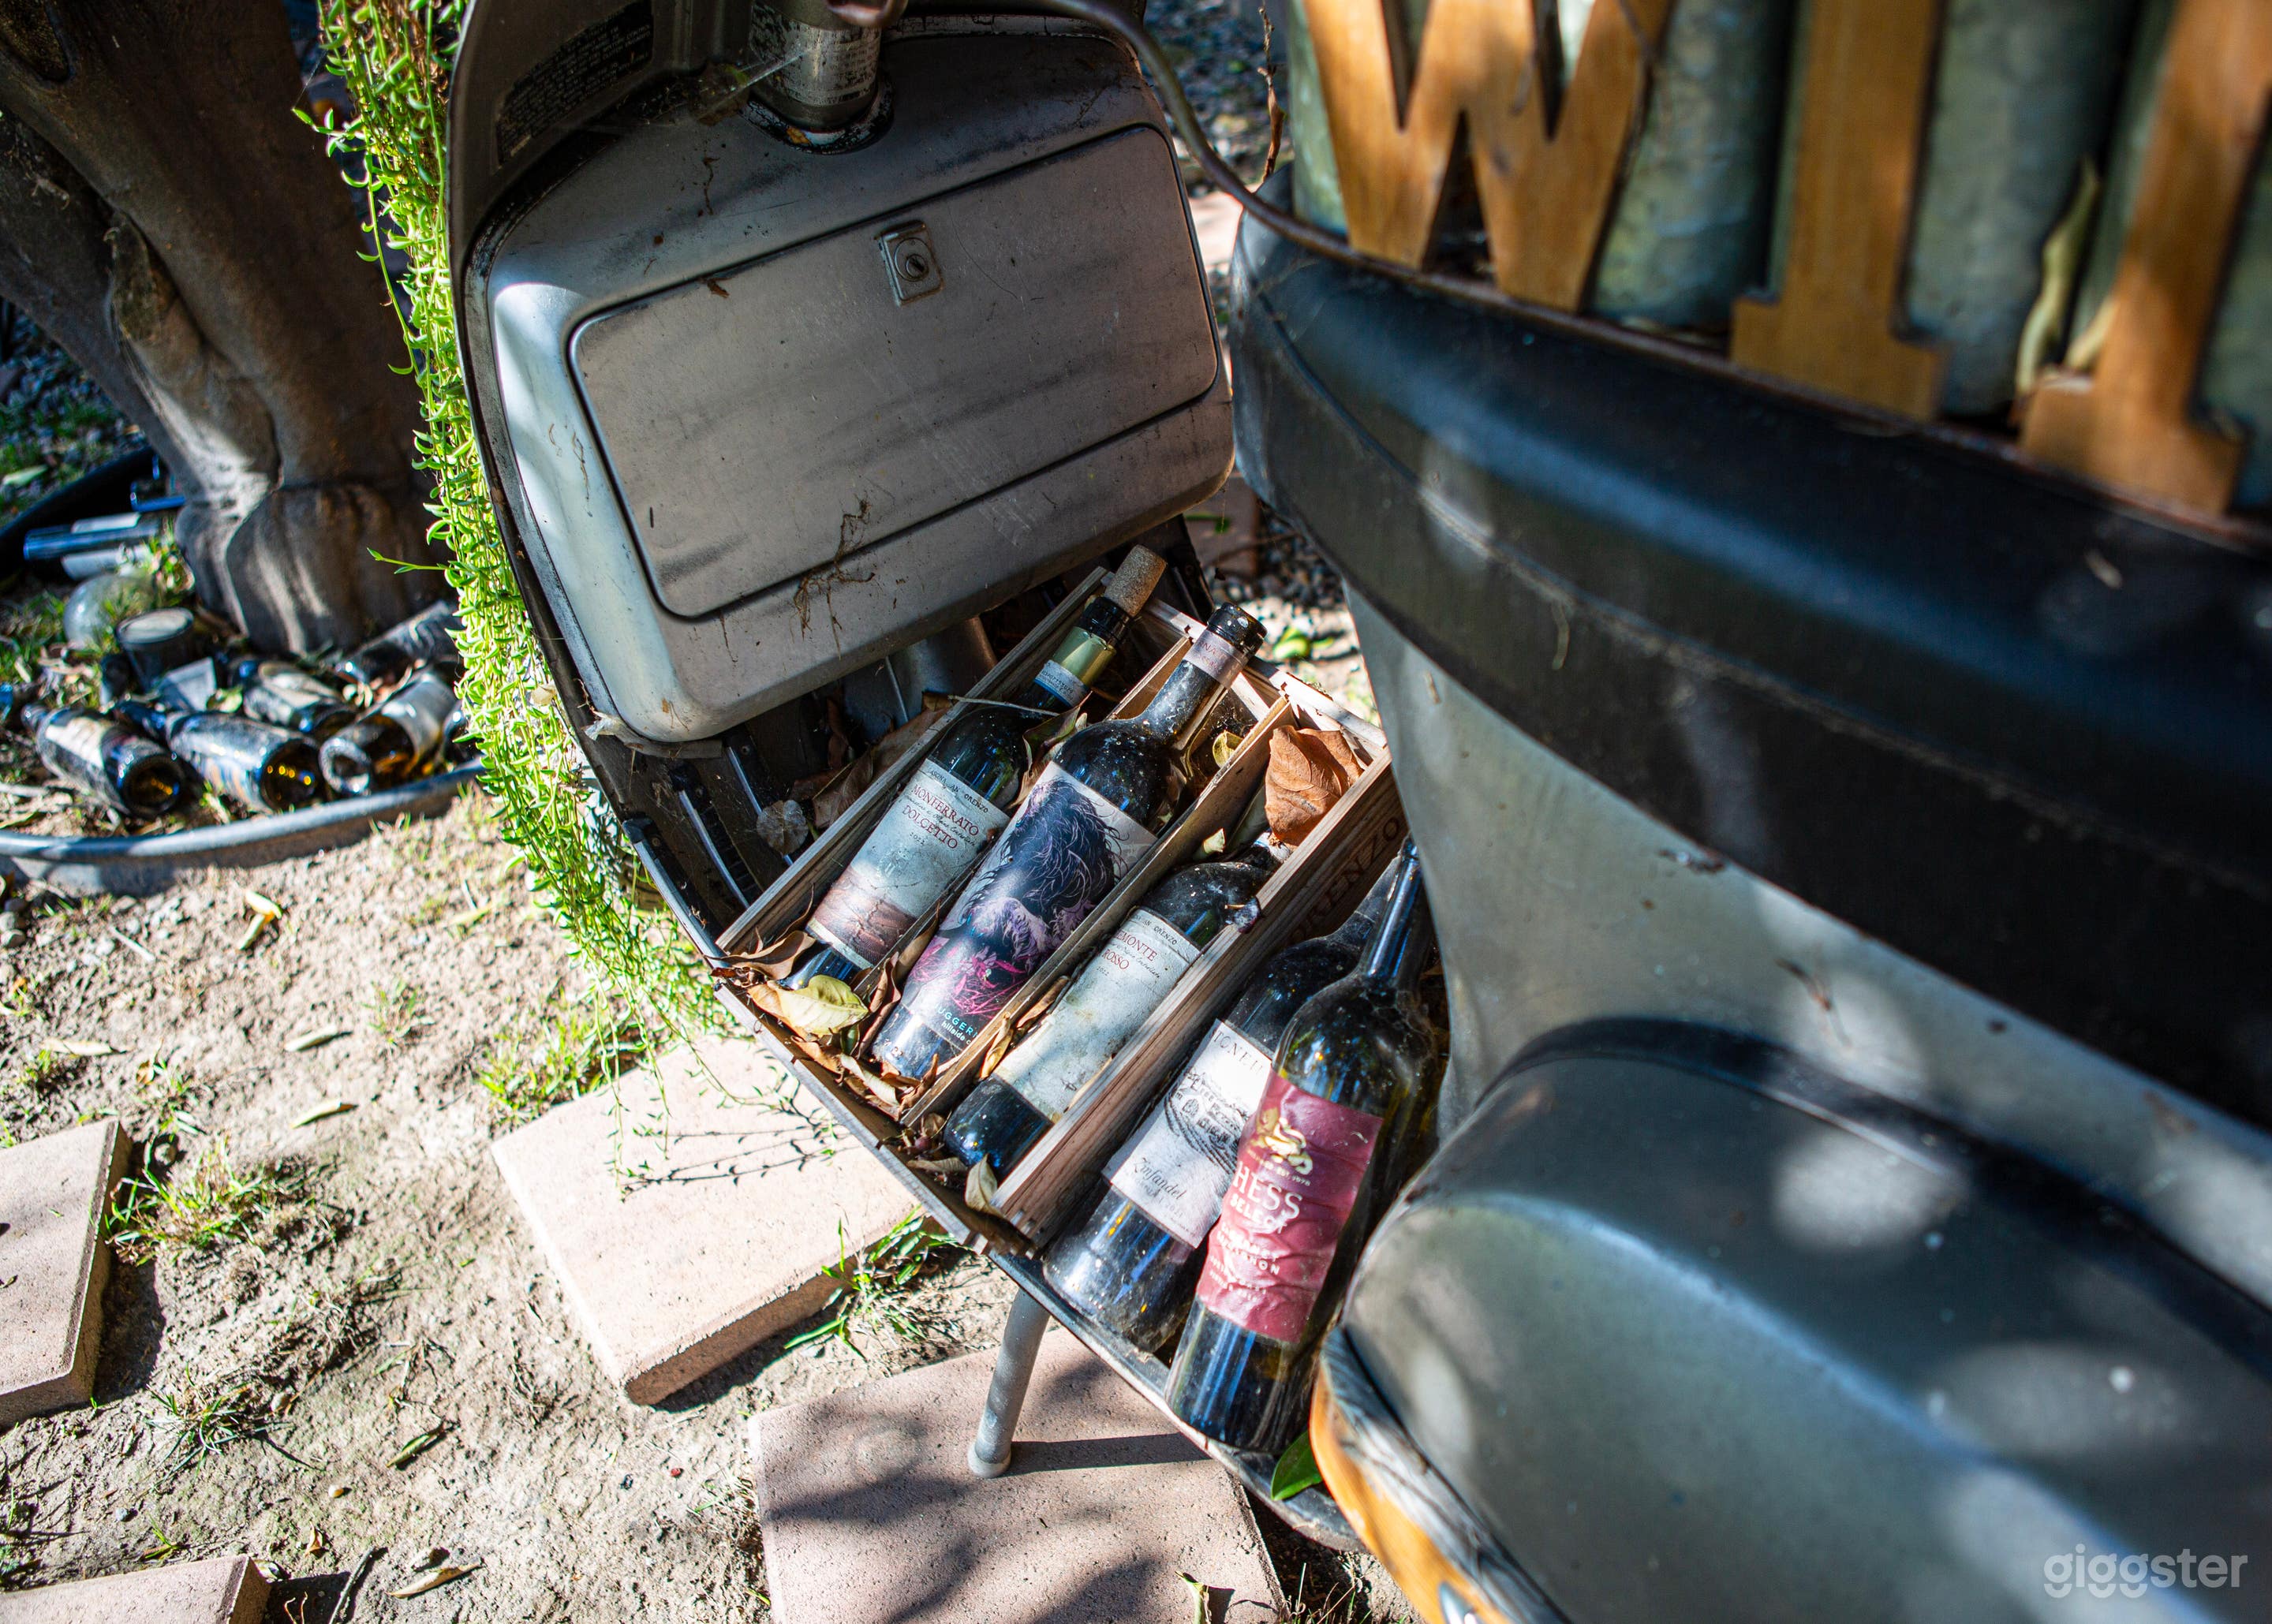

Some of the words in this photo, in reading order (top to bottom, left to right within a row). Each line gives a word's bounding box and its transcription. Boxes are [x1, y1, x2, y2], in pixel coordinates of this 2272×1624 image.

[902, 805, 958, 849] DOLCETTO
[911, 783, 980, 837] MONFERRATO
[1101, 948, 1130, 970] ROSSO
[1116, 930, 1158, 962] EMONTE
[941, 1020, 966, 1041] hillside
[1134, 1156, 1187, 1200] Zinfandel
[1232, 1160, 1303, 1219] HESS
[1230, 1193, 1288, 1234] SELECT
